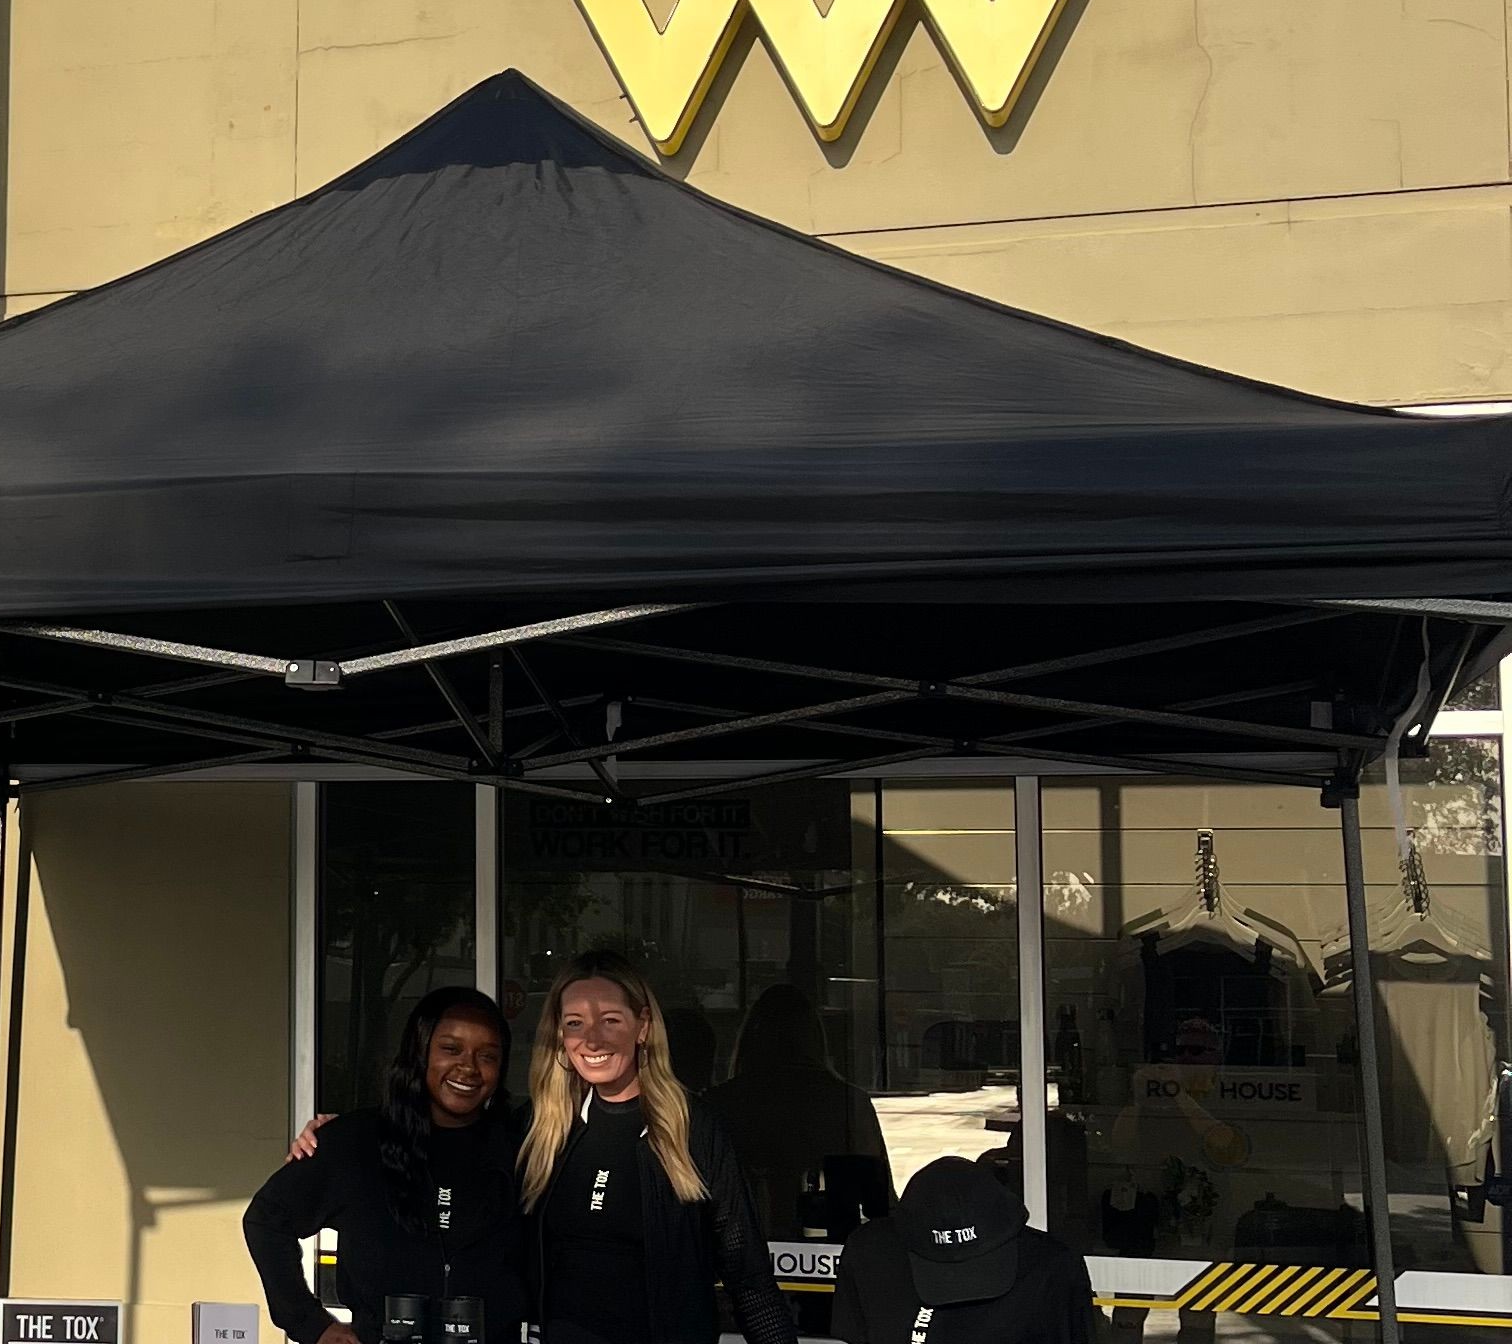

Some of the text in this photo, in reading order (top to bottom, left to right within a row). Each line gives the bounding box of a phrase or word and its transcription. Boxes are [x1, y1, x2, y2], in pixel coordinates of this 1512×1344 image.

[1220, 1081, 1303, 1102] HOUSE
[437, 1186, 452, 1206] TOX
[590, 1169, 610, 1211] THE TOX
[932, 1226, 977, 1244] THE TOX
[16, 1314, 54, 1339] THE
[914, 1306, 934, 1329] TOX
[214, 1328, 229, 1340] THE
